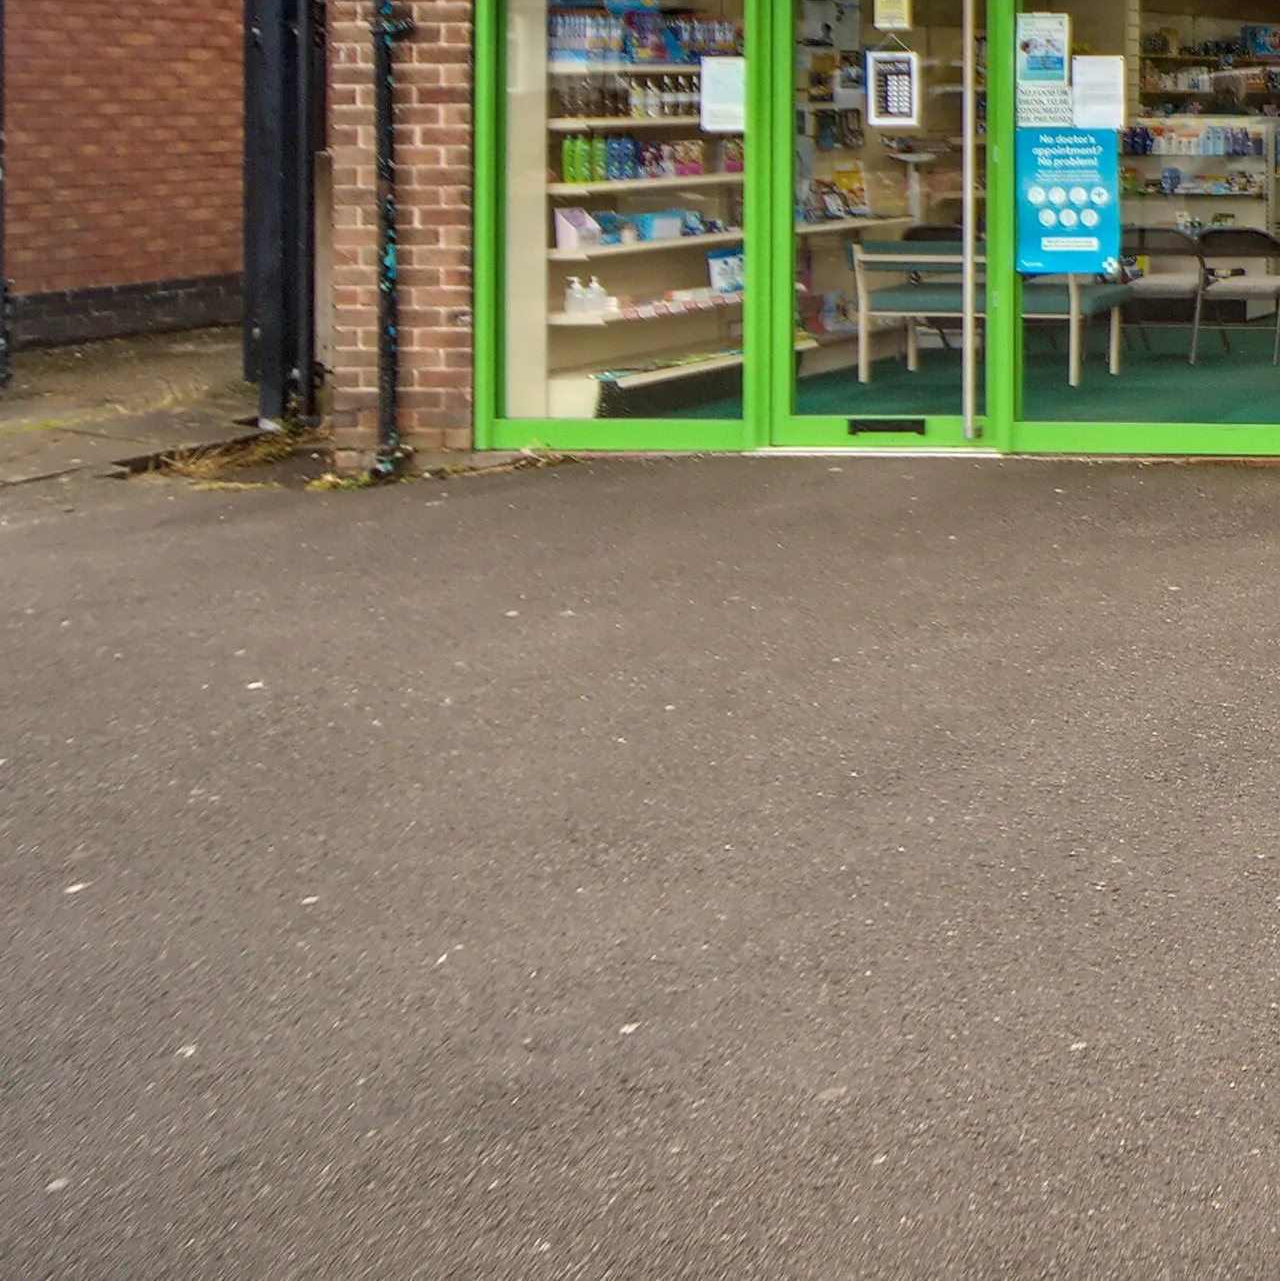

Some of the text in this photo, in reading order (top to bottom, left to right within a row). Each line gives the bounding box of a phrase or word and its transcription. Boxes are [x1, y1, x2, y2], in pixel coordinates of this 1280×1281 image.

[1039, 134, 1096, 144] No doctor's
[1032, 146, 1103, 157] appointment?
[1037, 157, 1098, 168] No problem!
